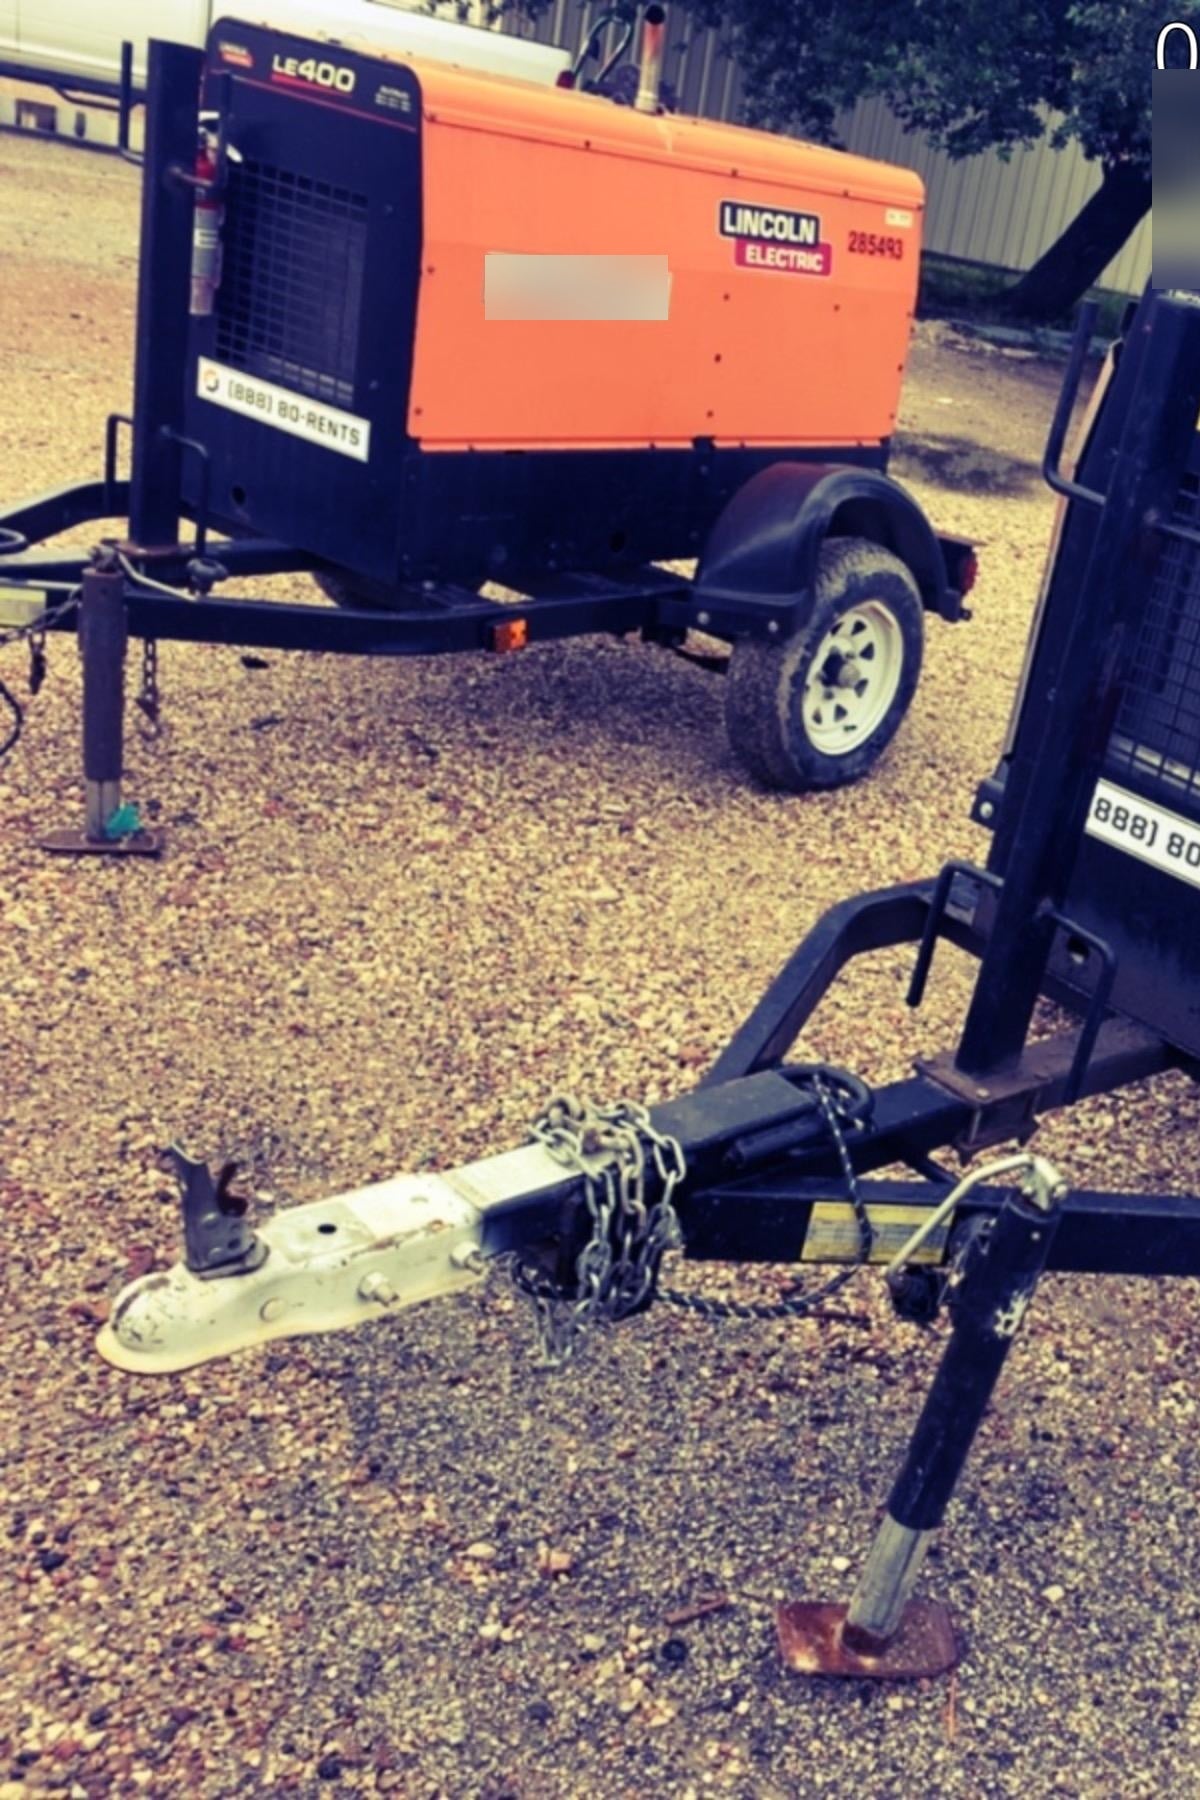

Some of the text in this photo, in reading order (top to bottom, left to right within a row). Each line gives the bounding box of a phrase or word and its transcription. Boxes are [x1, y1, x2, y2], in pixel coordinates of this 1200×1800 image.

[272, 54, 356, 93] LE400
[723, 205, 816, 244] LINCOLN
[746, 244, 823, 272] ELECTRIC
[848, 230, 904, 260] 285493
[227, 379, 361, 446] (888) 80-RENTS
[1093, 796, 1159, 847] 888)
